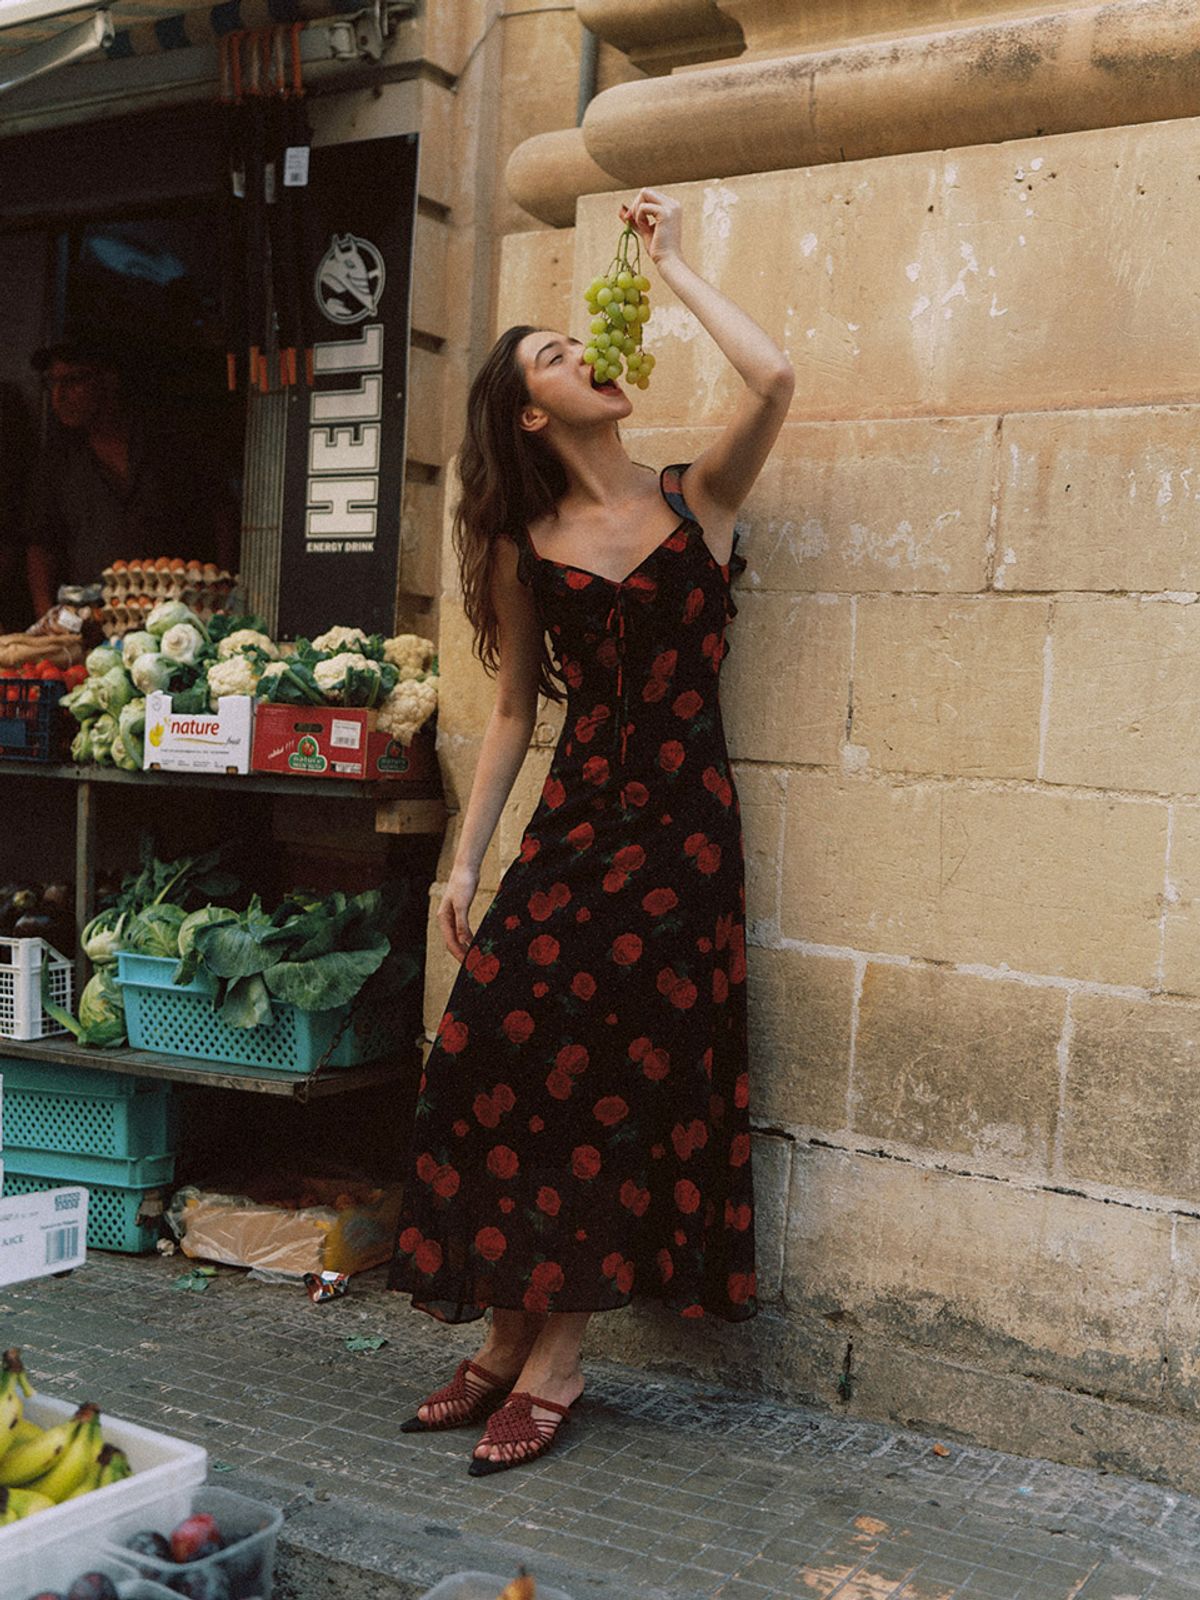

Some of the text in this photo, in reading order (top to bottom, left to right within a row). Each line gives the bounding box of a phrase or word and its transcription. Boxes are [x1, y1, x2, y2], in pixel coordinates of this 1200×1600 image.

[305, 323, 384, 538] HELL
[306, 541, 375, 553] ENERGY DRINK
[170, 720, 220, 736] nature
